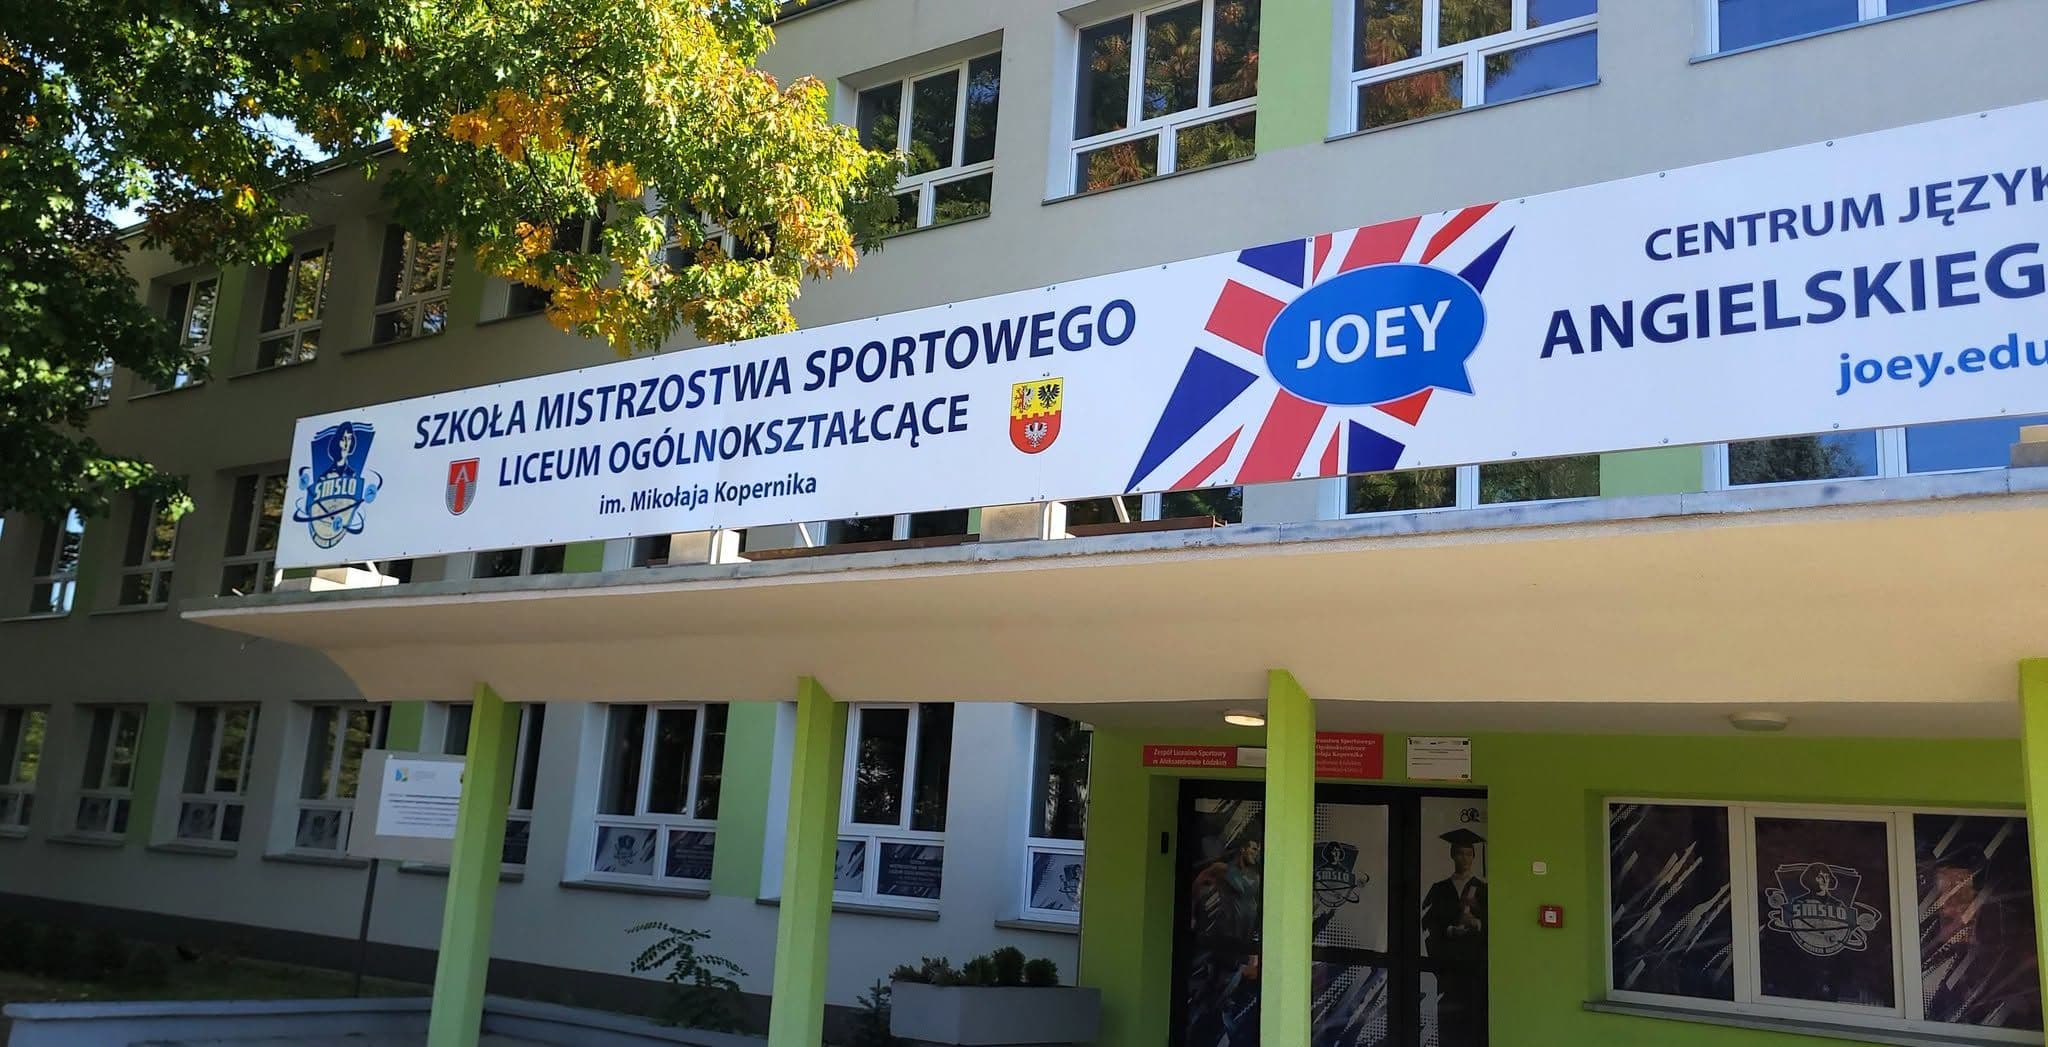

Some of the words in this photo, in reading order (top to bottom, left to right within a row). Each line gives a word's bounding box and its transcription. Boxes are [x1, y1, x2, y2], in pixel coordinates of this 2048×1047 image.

[1645, 192, 1885, 261] CENTRUM
[1296, 299, 1452, 370] JOEY
[1539, 242, 2047, 359] ANGIELSKIEG
[413, 399, 526, 450] SZKOŁA
[534, 356, 792, 432] MISTRZOSTWA
[803, 298, 1136, 392] SPORTOWEGO
[1835, 332, 2048, 396] joey.edu
[498, 444, 601, 487] LICEUM
[608, 393, 970, 474] OGÓLNOKSZTAŁCĄCE
[314, 477, 358, 500] SMSLO
[599, 496, 626, 515] im.
[630, 484, 709, 512] Mikołaja
[714, 471, 817, 507] Kopernika
[1791, 902, 1848, 921] SMSLO
